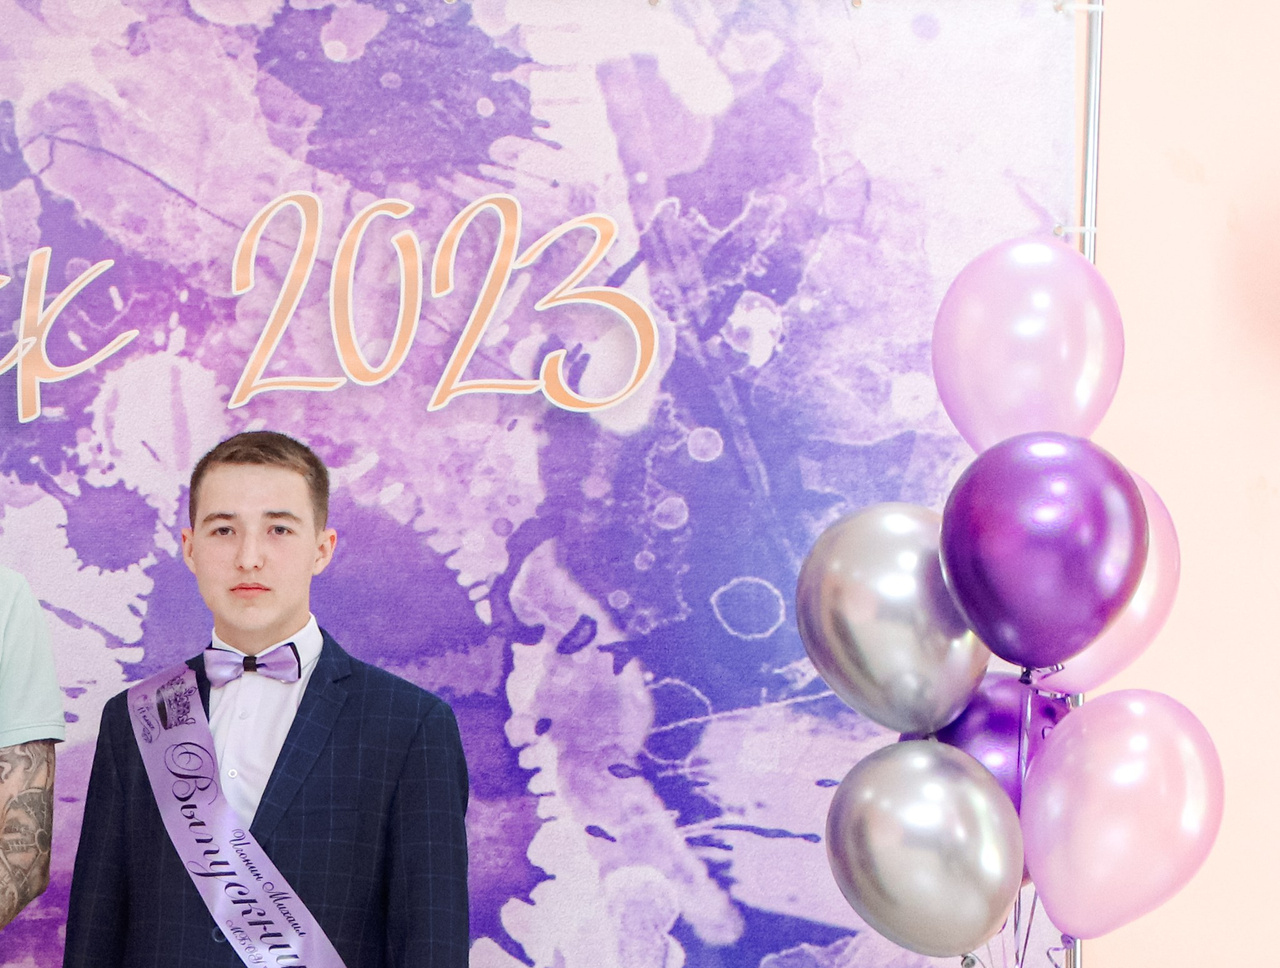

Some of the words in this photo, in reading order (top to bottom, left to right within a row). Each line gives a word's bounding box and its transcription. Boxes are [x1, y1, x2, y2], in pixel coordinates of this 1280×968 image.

[229, 191, 660, 412] 2023
[229, 828, 263, 881] Игонин
[262, 881, 307, 937] Михаил
